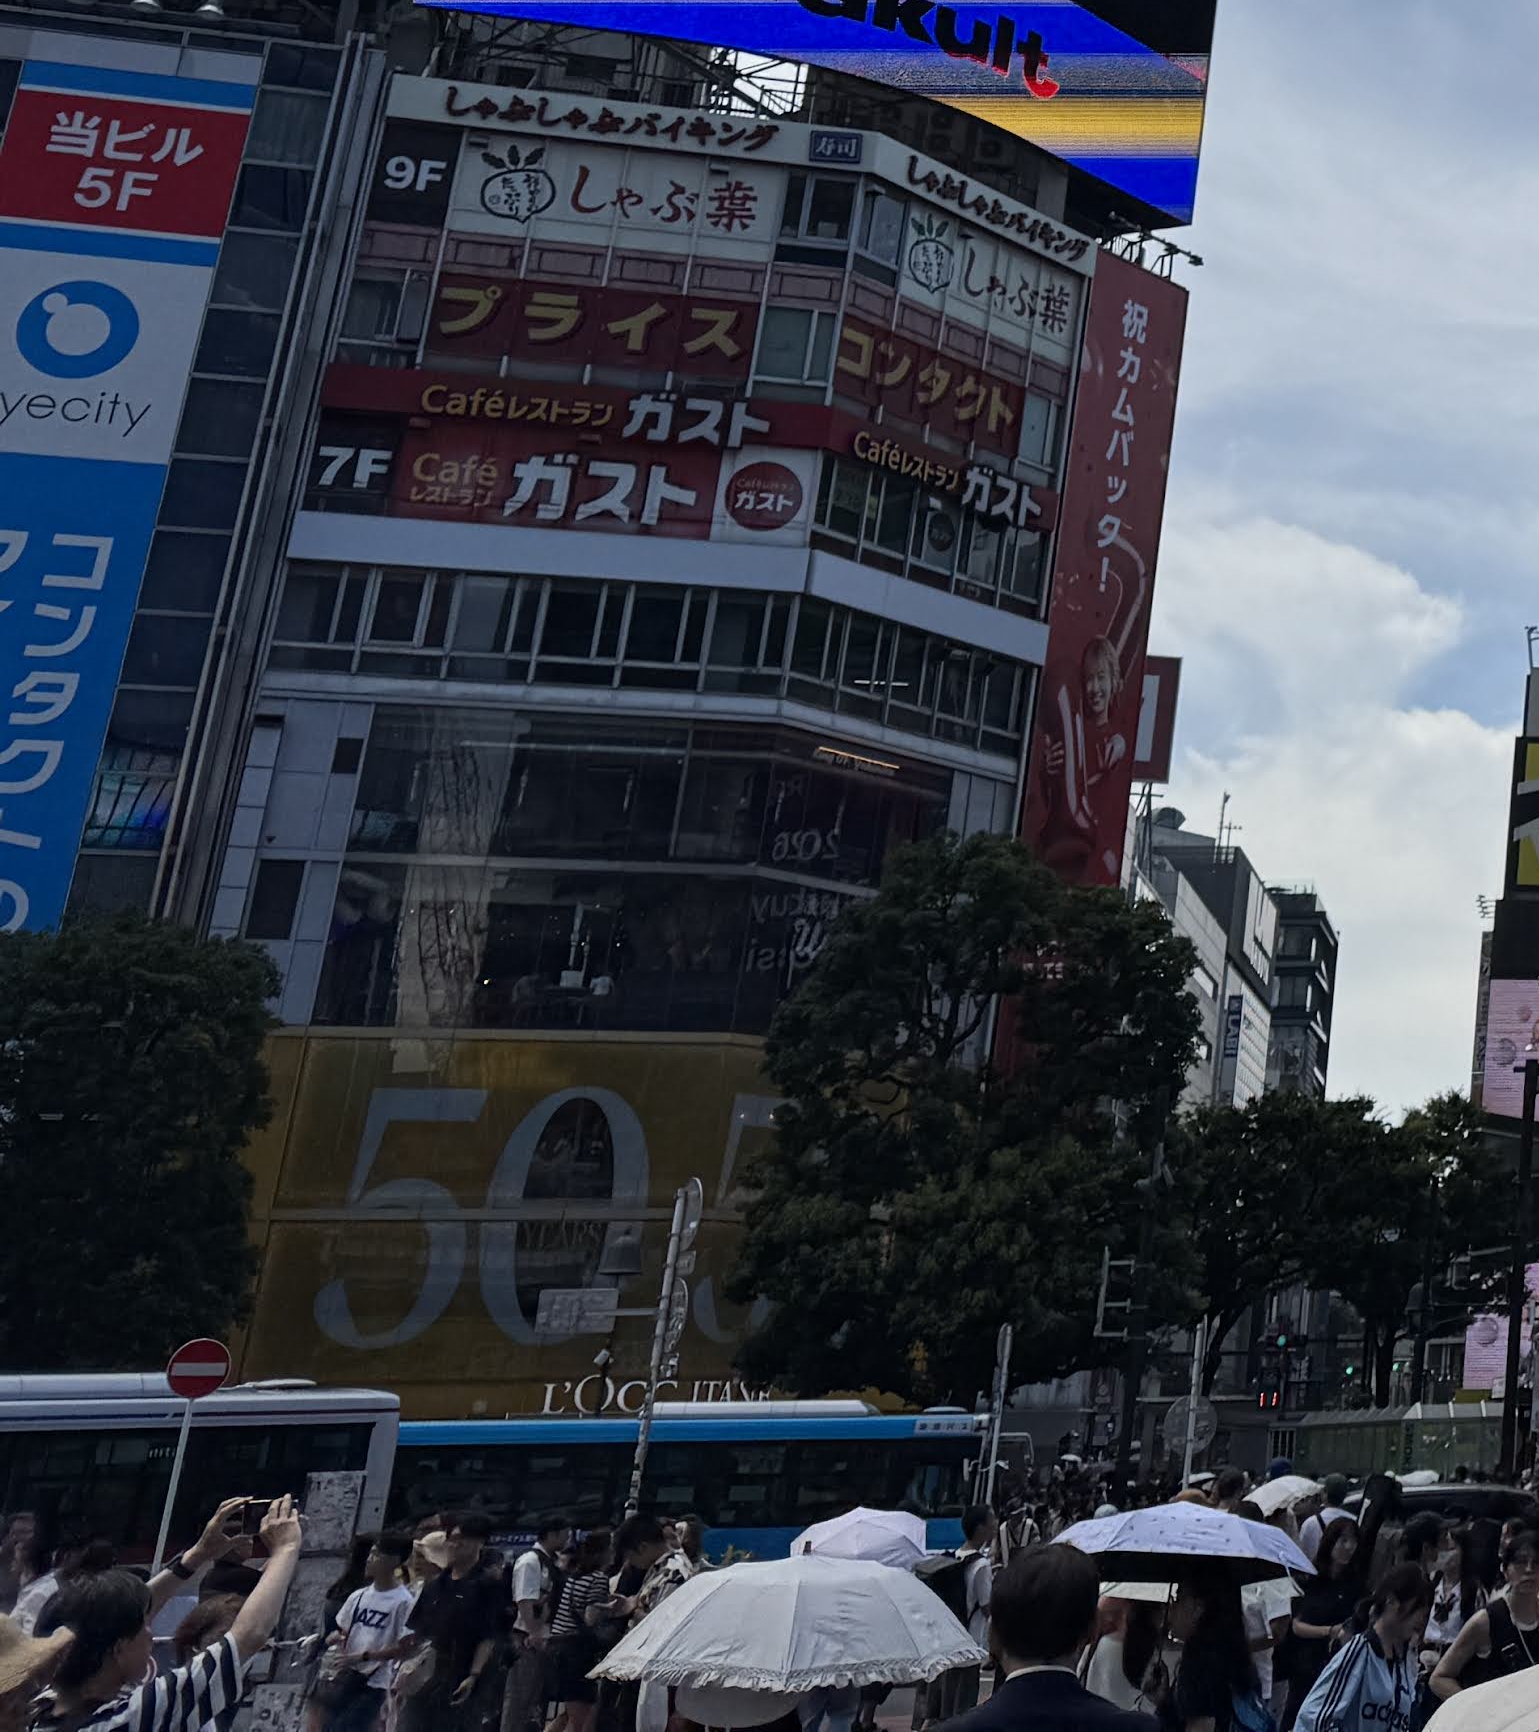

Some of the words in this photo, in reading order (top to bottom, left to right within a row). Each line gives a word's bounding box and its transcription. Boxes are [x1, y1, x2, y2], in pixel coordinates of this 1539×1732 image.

[45, 110, 204, 167] 当ビル
[445, 86, 780, 151] しゃぶしゃぶバイキング
[73, 168, 159, 211] 5F
[383, 154, 447, 193] 9F
[570, 164, 758, 233] しゃぶ葉
[963, 246, 1071, 334] しゃぶ葉
[438, 285, 744, 358] プライス
[836, 326, 1014, 433] コンタクト
[0, 390, 152, 437] yecity
[421, 385, 505, 419] Café
[506, 395, 613, 427] レストラン
[622, 393, 771, 447] ガスト
[317, 446, 392, 489] 7F
[412, 452, 499, 484] Café
[502, 452, 697, 527] ガスト
[853, 431, 901, 470] Café
[900, 450, 960, 490] レストラン
[961, 464, 1042, 526] ガスト
[734, 492, 793, 513] ガスト
